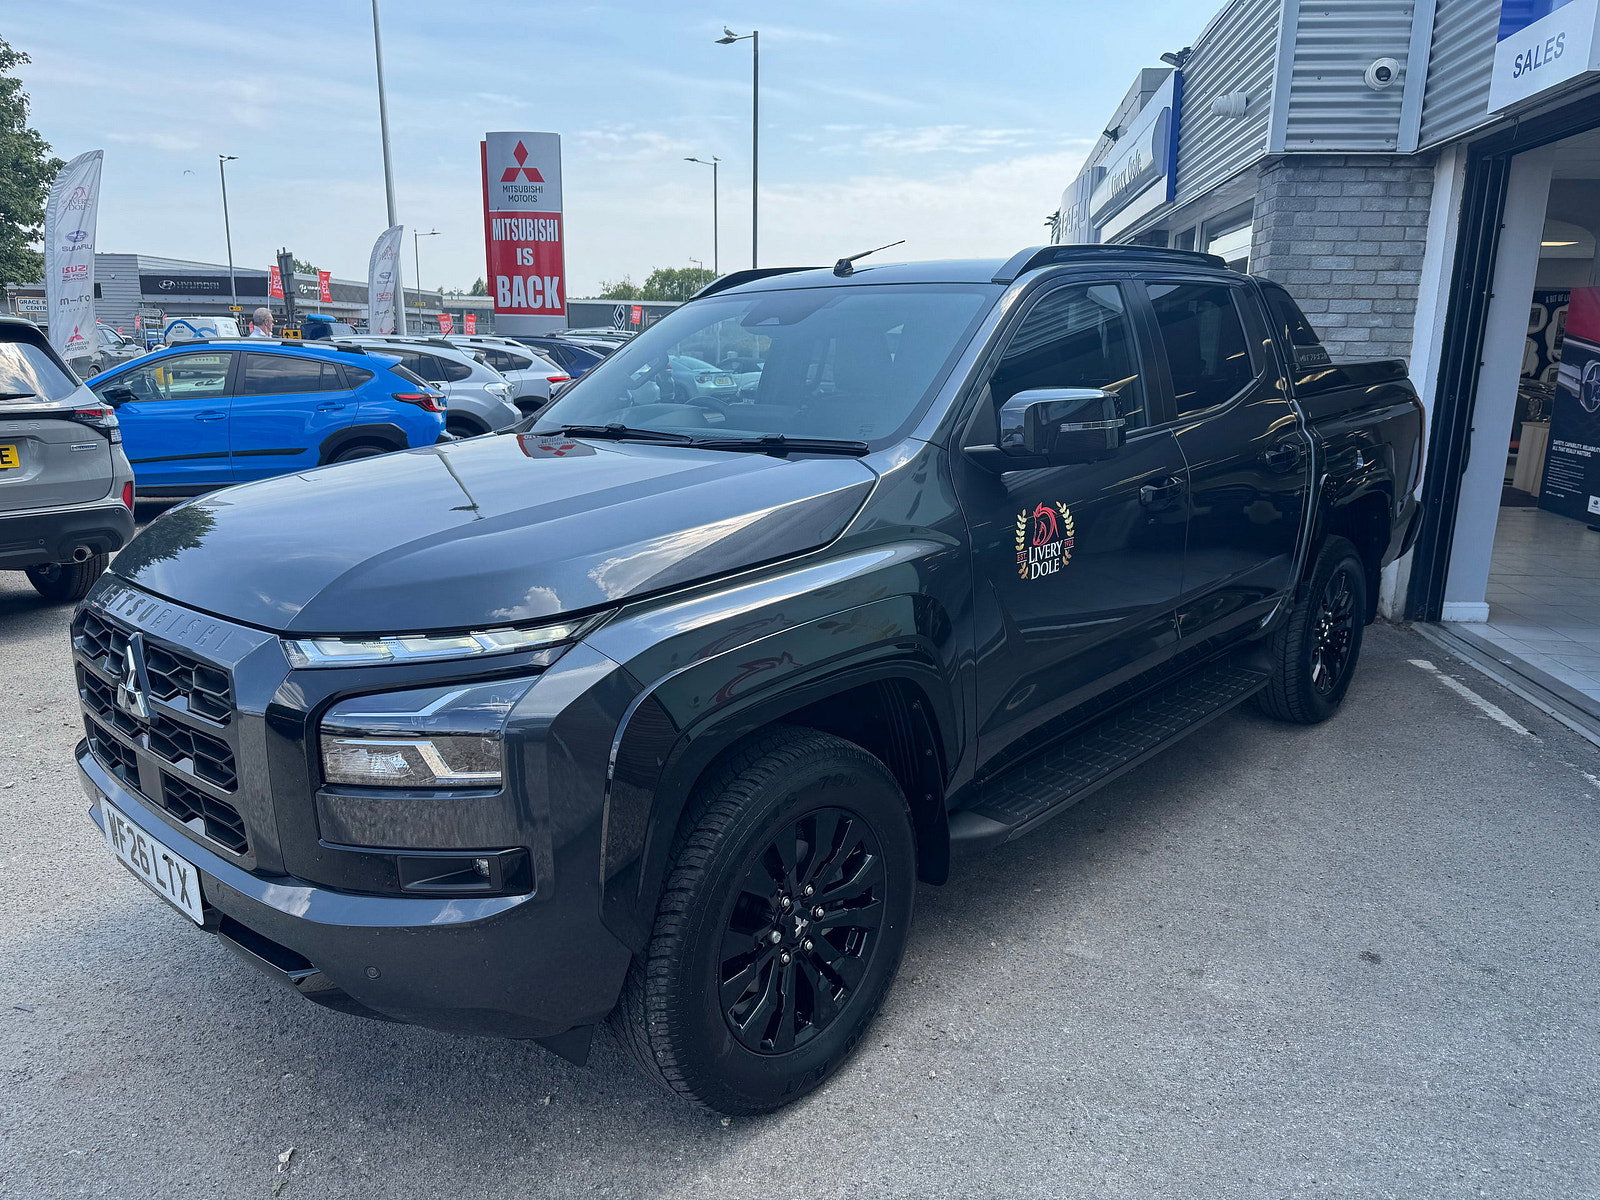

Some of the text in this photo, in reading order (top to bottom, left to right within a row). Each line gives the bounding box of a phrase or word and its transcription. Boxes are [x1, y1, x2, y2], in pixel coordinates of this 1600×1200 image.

[1513, 32, 1566, 79] SALES
[502, 185, 544, 194] MITSUBISHI
[508, 194, 538, 203] MOTORS
[492, 218, 559, 242] MITSUBISHI
[516, 247, 534, 266] IS
[176, 281, 220, 290] HYUNDAI
[496, 275, 561, 309] BACK
[0, 447, 13, 464] E
[1029, 540, 1063, 564] LIVERY
[1031, 557, 1060, 580] DOLE
[97, 583, 236, 653] MITSUBISHI
